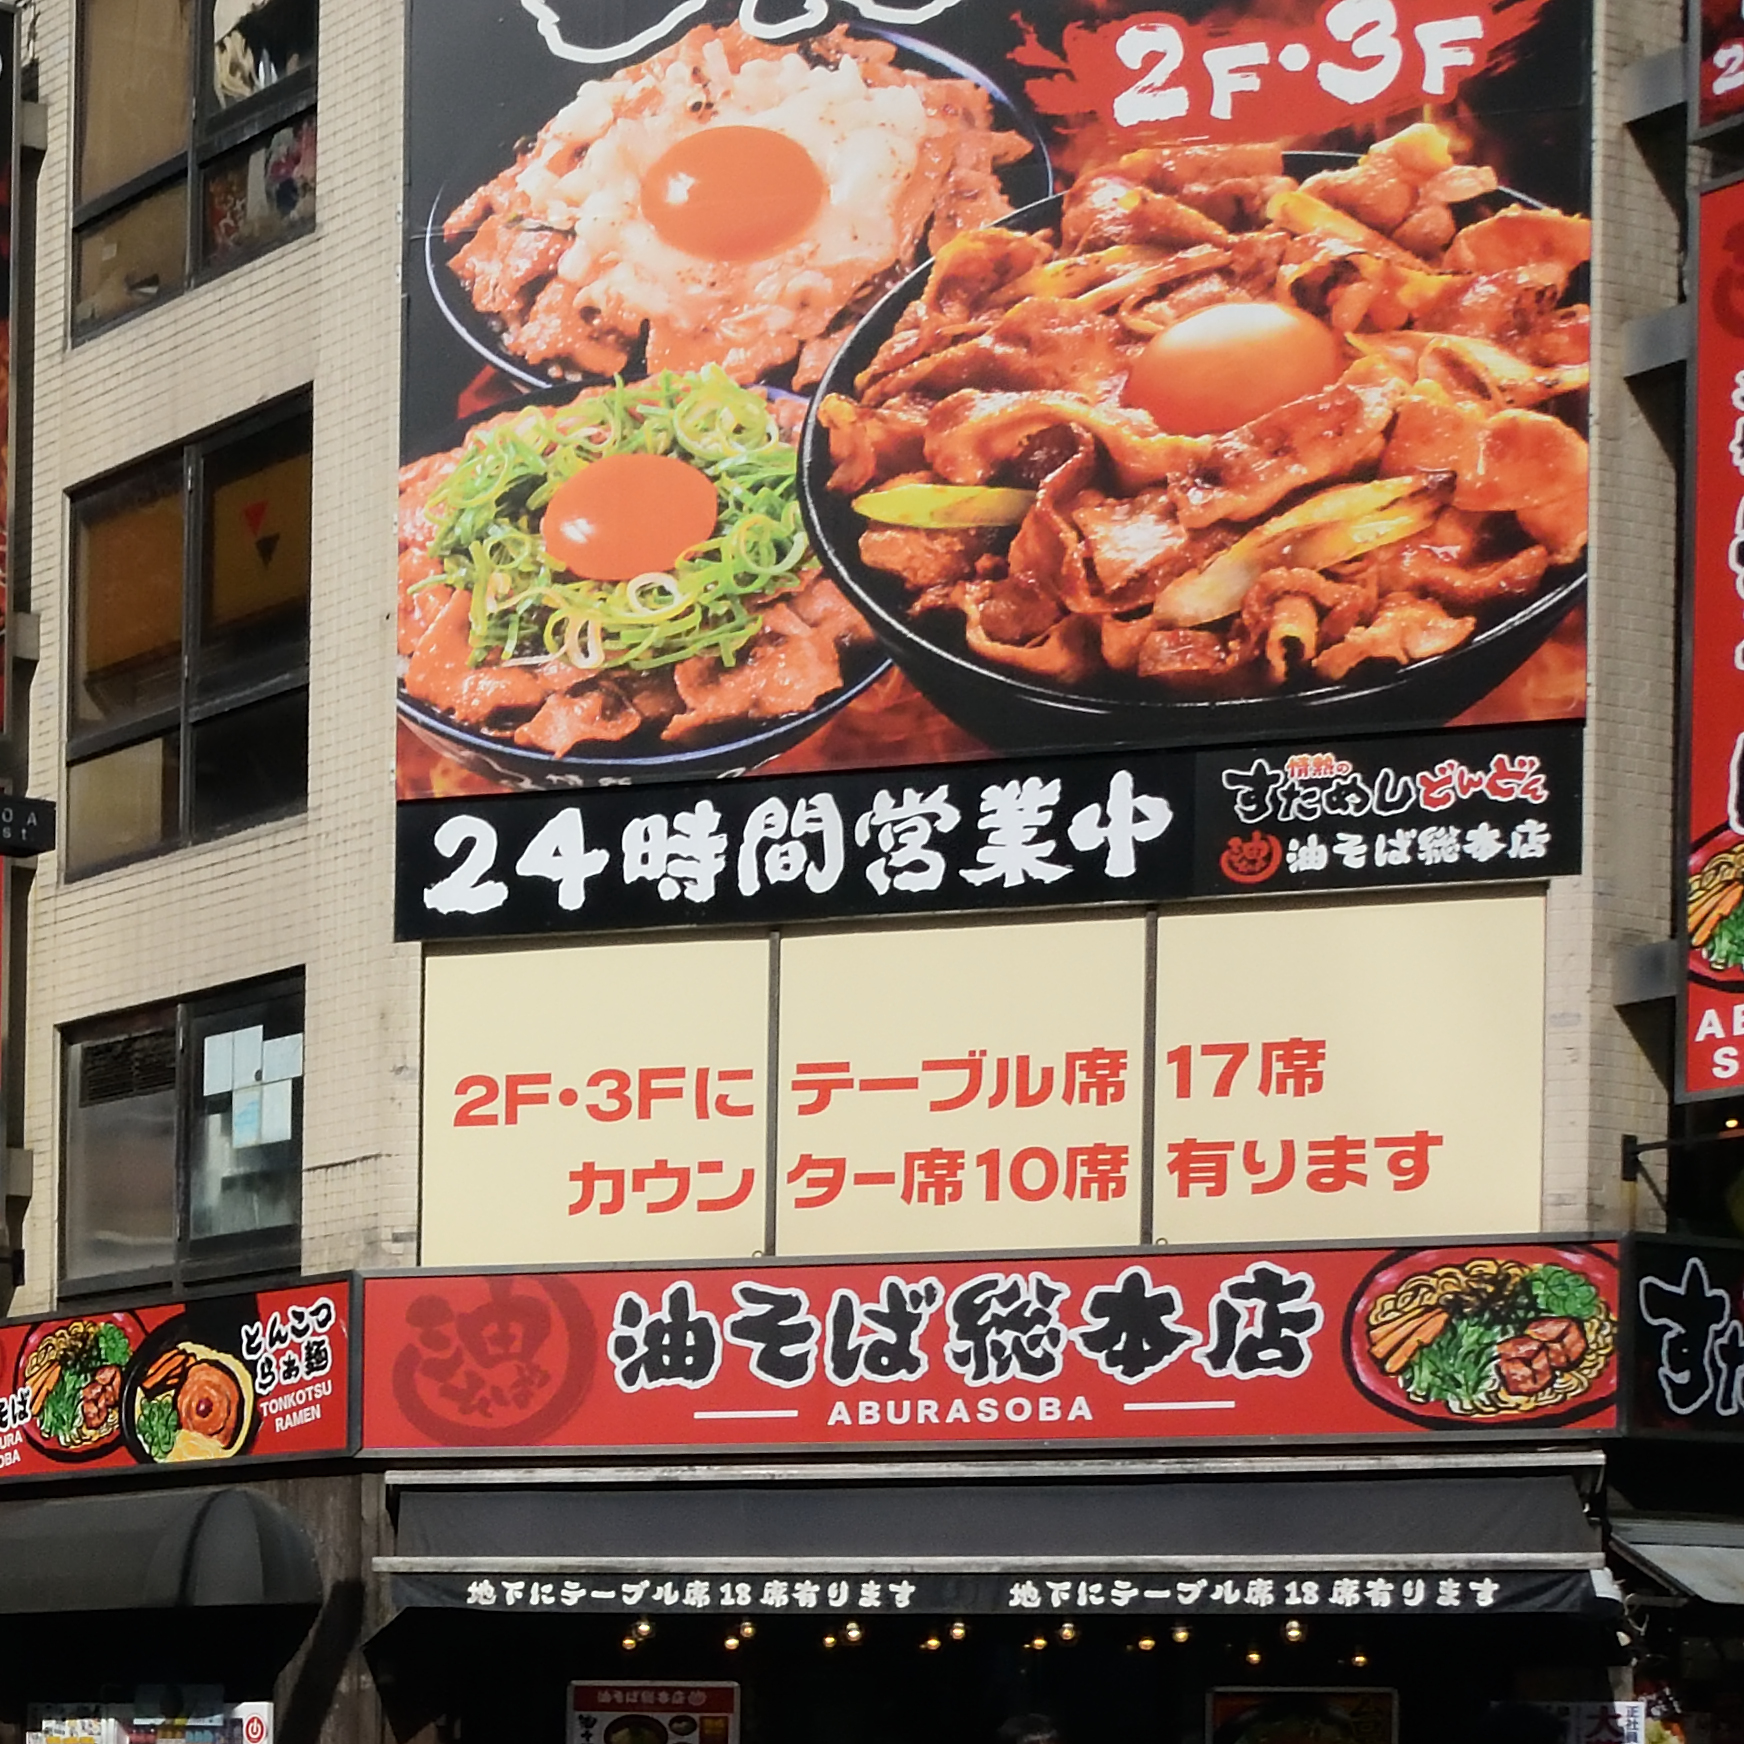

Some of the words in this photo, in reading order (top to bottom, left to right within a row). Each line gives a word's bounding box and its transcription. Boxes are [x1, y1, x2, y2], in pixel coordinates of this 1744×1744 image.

[423, 770, 1173, 915] 24時間営業中
[1285, 819, 1552, 873] 油そば総本店
[607, 1259, 1326, 1393] 油そば総本店
[259, 1379, 333, 1418] TONKOTSU
[275, 1403, 322, 1433] RAMEN
[827, 1396, 1094, 1427] ABURASOBA
